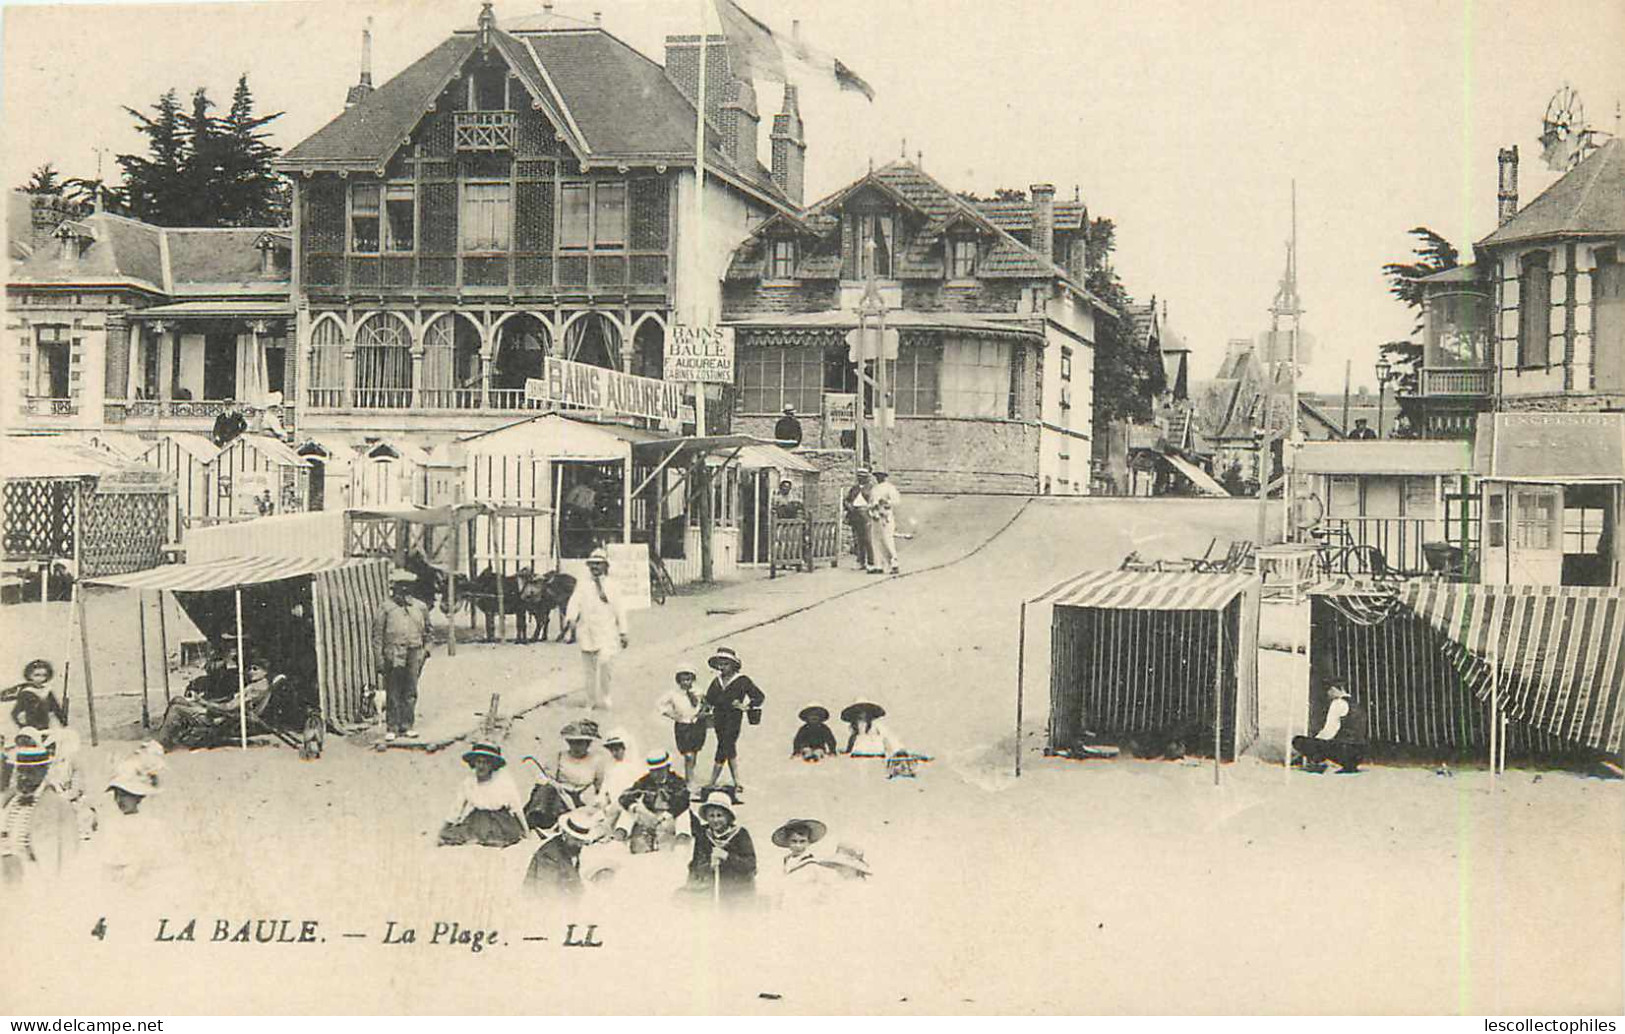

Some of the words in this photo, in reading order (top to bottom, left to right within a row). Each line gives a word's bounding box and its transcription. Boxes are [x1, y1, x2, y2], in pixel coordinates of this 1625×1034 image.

[672, 327, 724, 338] BAINS
[669, 344, 727, 356] BAULE
[549, 359, 601, 404] BAINS
[606, 371, 681, 420] AUDUREAU
